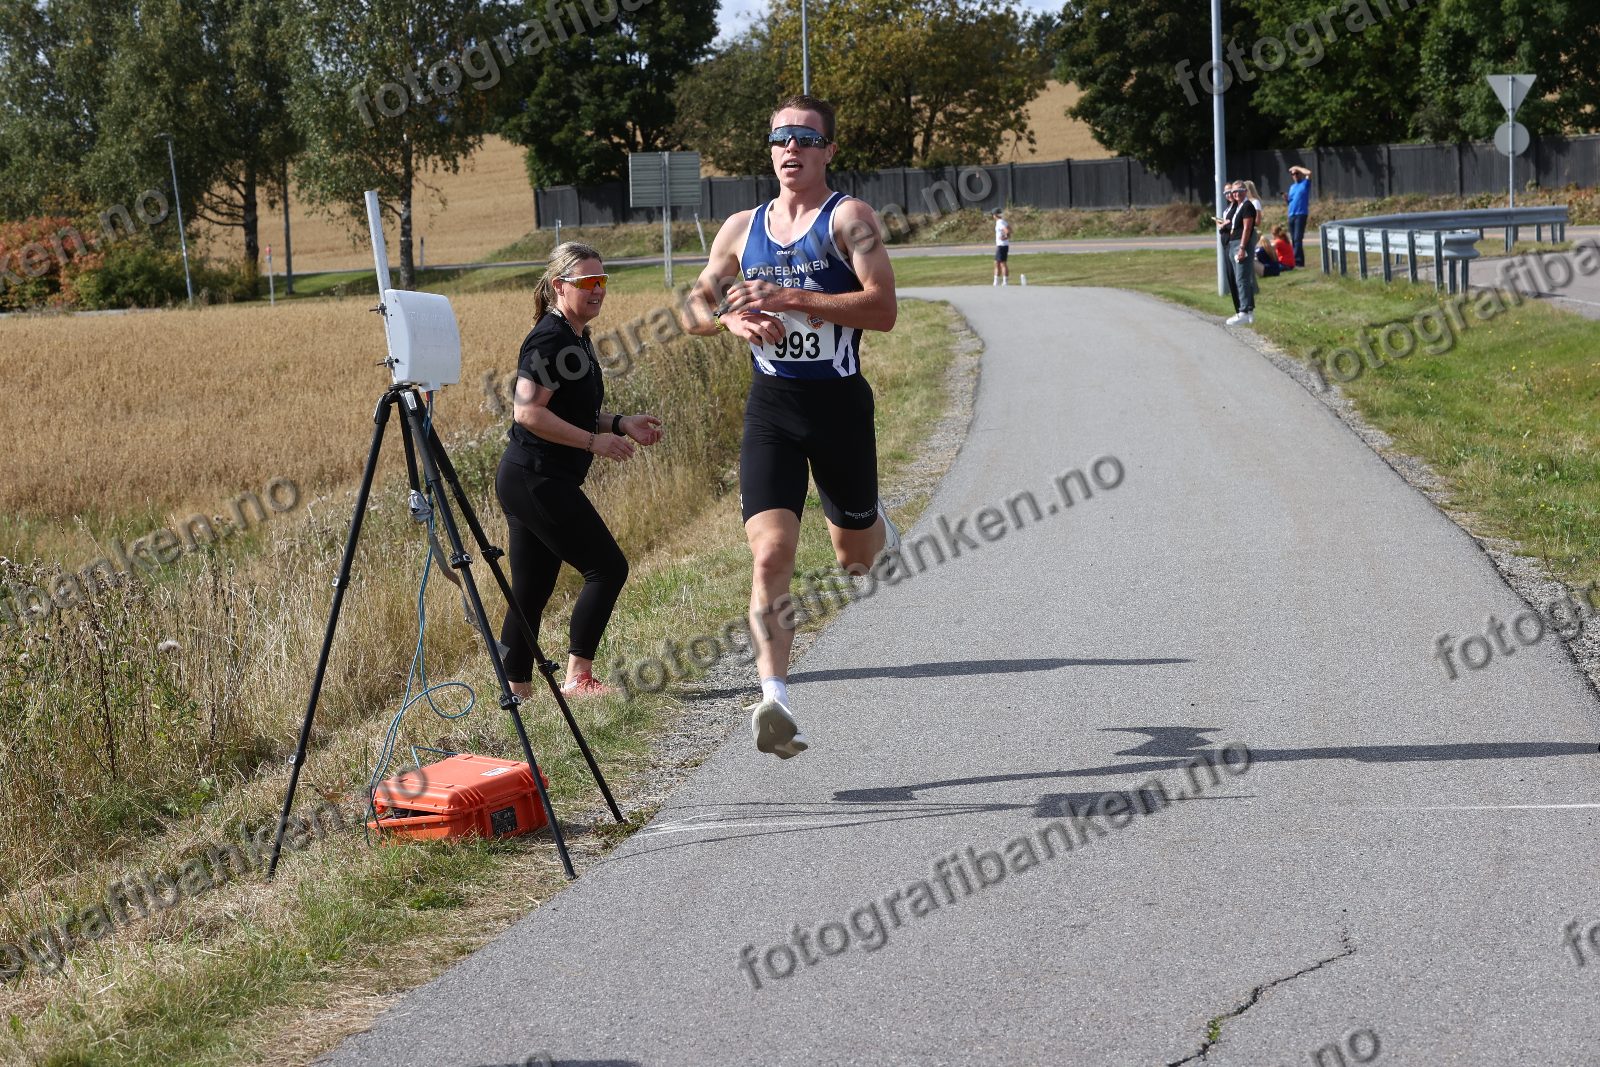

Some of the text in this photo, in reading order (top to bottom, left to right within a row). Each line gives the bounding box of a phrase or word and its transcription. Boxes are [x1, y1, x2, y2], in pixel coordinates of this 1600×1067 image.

[747, 259, 829, 278] SPAREBANKEN
[776, 278, 801, 287] SØR
[775, 331, 820, 359] 993
